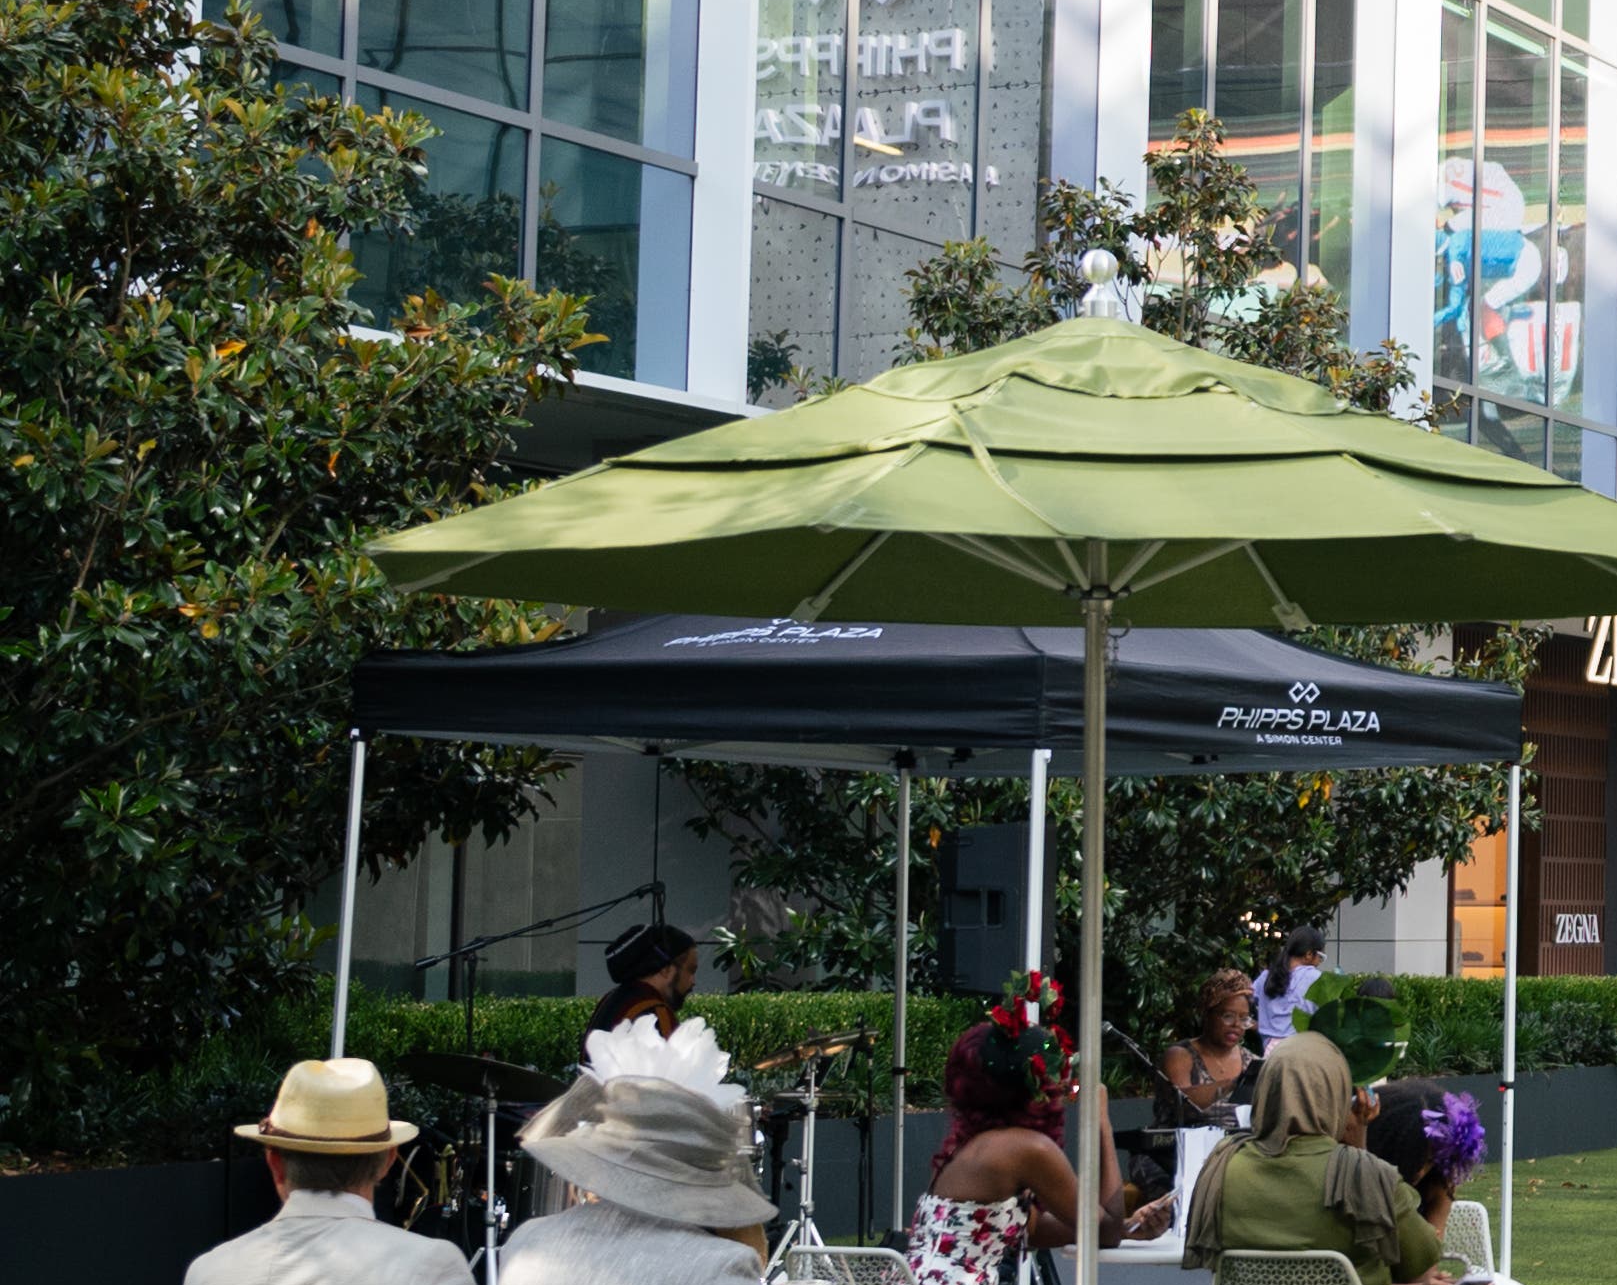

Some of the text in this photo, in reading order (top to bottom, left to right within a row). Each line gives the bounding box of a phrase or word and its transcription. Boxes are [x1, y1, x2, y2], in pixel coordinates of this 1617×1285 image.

[663, 625, 884, 647] PHIPPS PLAZA
[1217, 706, 1381, 733] PHIPPS PLAZA
[1256, 733, 1343, 746] A SIMON CENTER
[1555, 913, 1601, 944] ZEGNA
